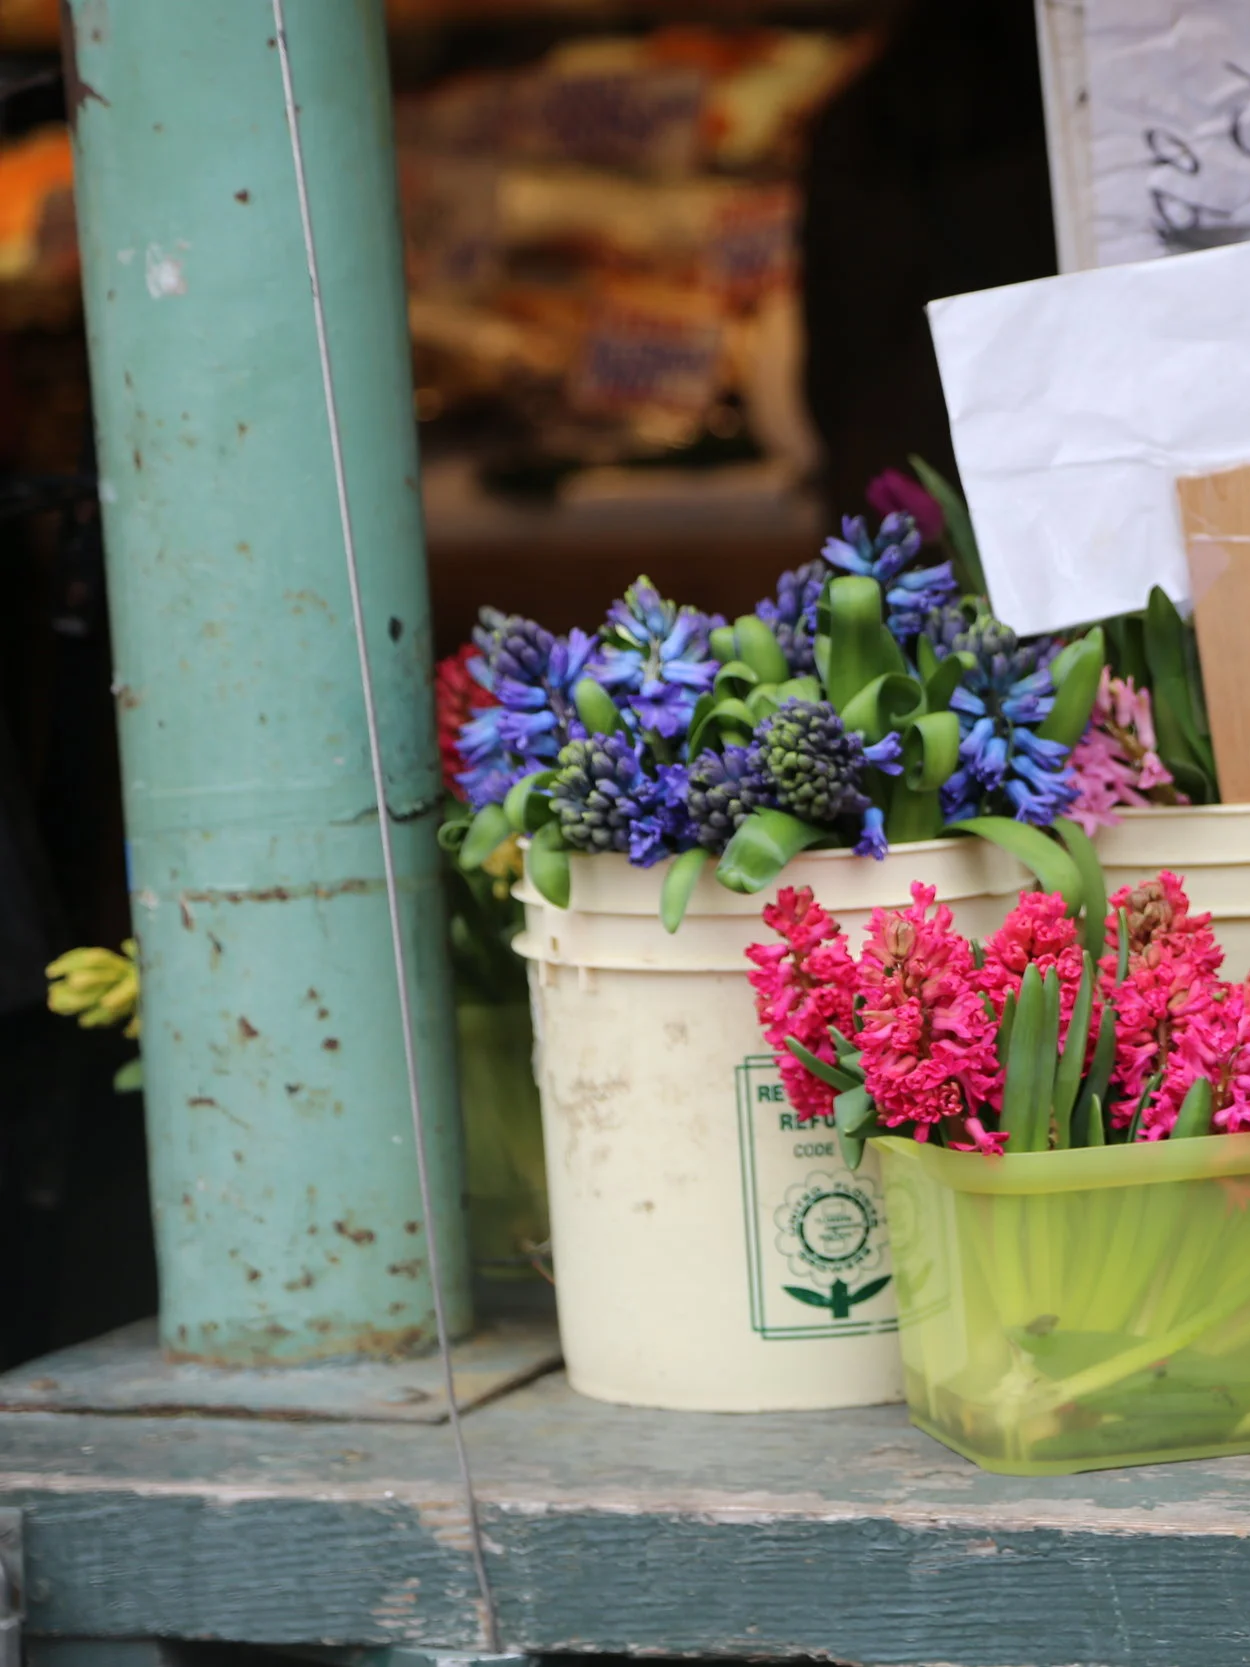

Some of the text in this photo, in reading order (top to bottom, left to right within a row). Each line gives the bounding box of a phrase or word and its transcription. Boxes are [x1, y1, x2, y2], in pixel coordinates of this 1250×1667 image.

[757, 1085, 784, 1102] RE
[779, 1112, 837, 1131] REFU
[793, 1142, 835, 1159] CODE
